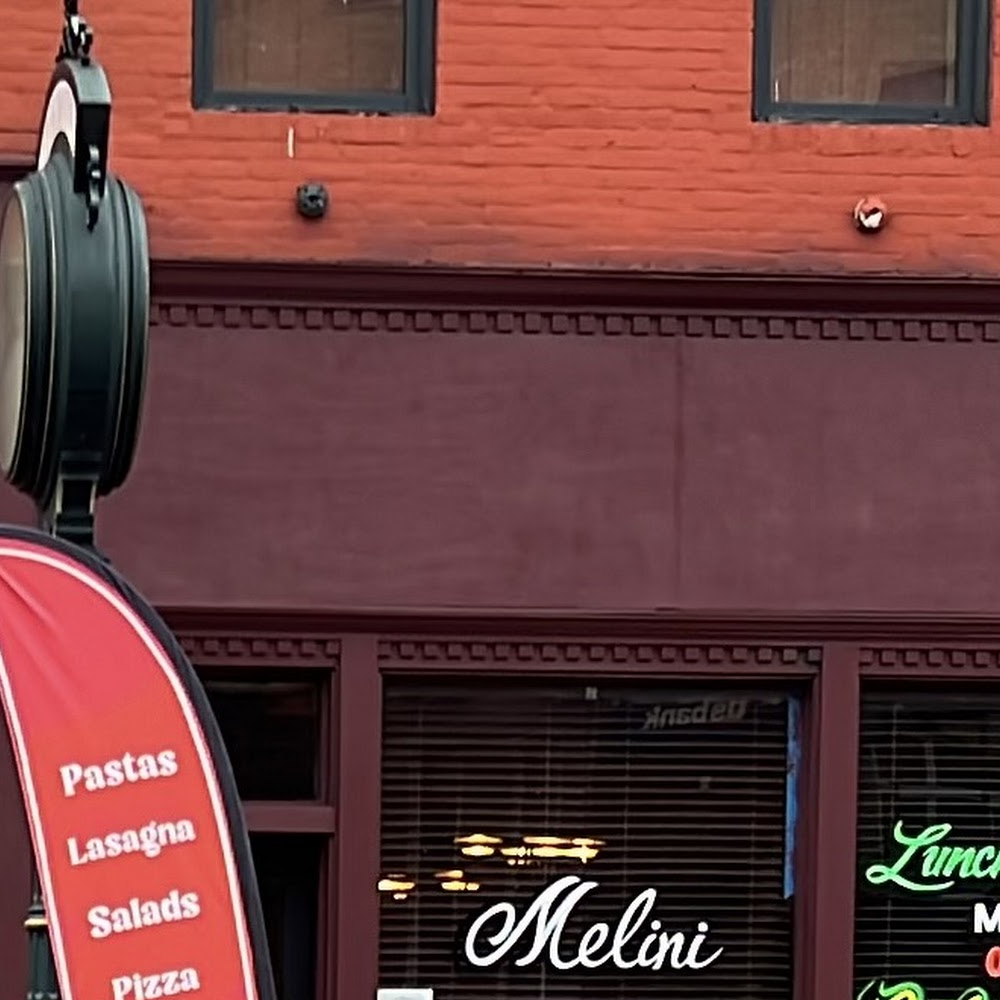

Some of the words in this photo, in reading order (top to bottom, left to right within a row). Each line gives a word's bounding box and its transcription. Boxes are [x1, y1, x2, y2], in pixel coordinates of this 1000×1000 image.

[60, 749, 178, 797] Pastas
[67, 819, 196, 866] Lasagna
[87, 890, 200, 939] Salads
[465, 875, 724, 970] Melini
